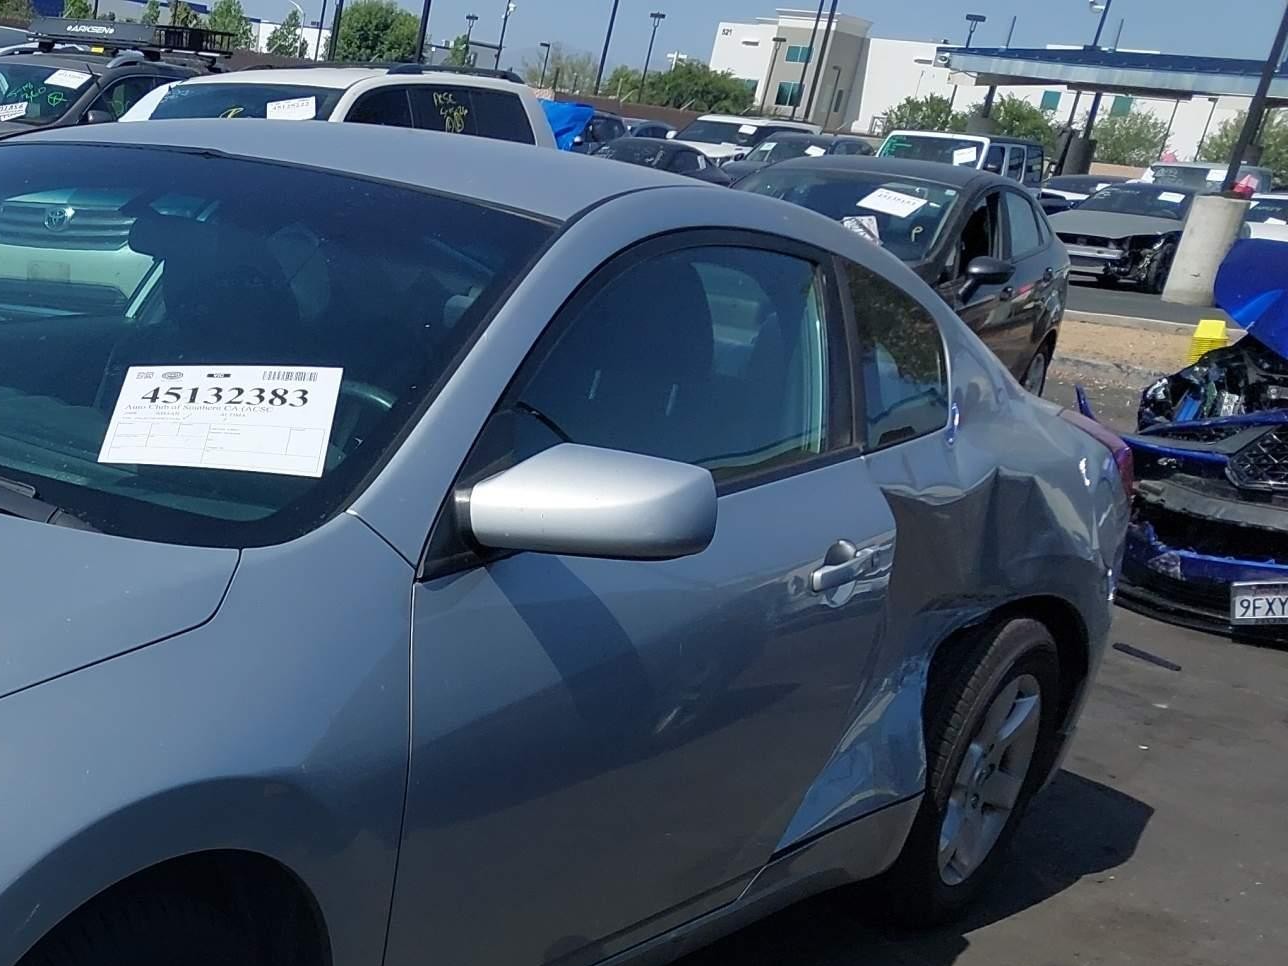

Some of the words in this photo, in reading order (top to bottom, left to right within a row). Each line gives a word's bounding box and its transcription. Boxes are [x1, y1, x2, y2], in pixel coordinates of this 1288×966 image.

[72, 25, 111, 34] ARKSEN
[141, 386, 309, 407] 45132383
[1240, 598, 1288, 617] 9FXY
